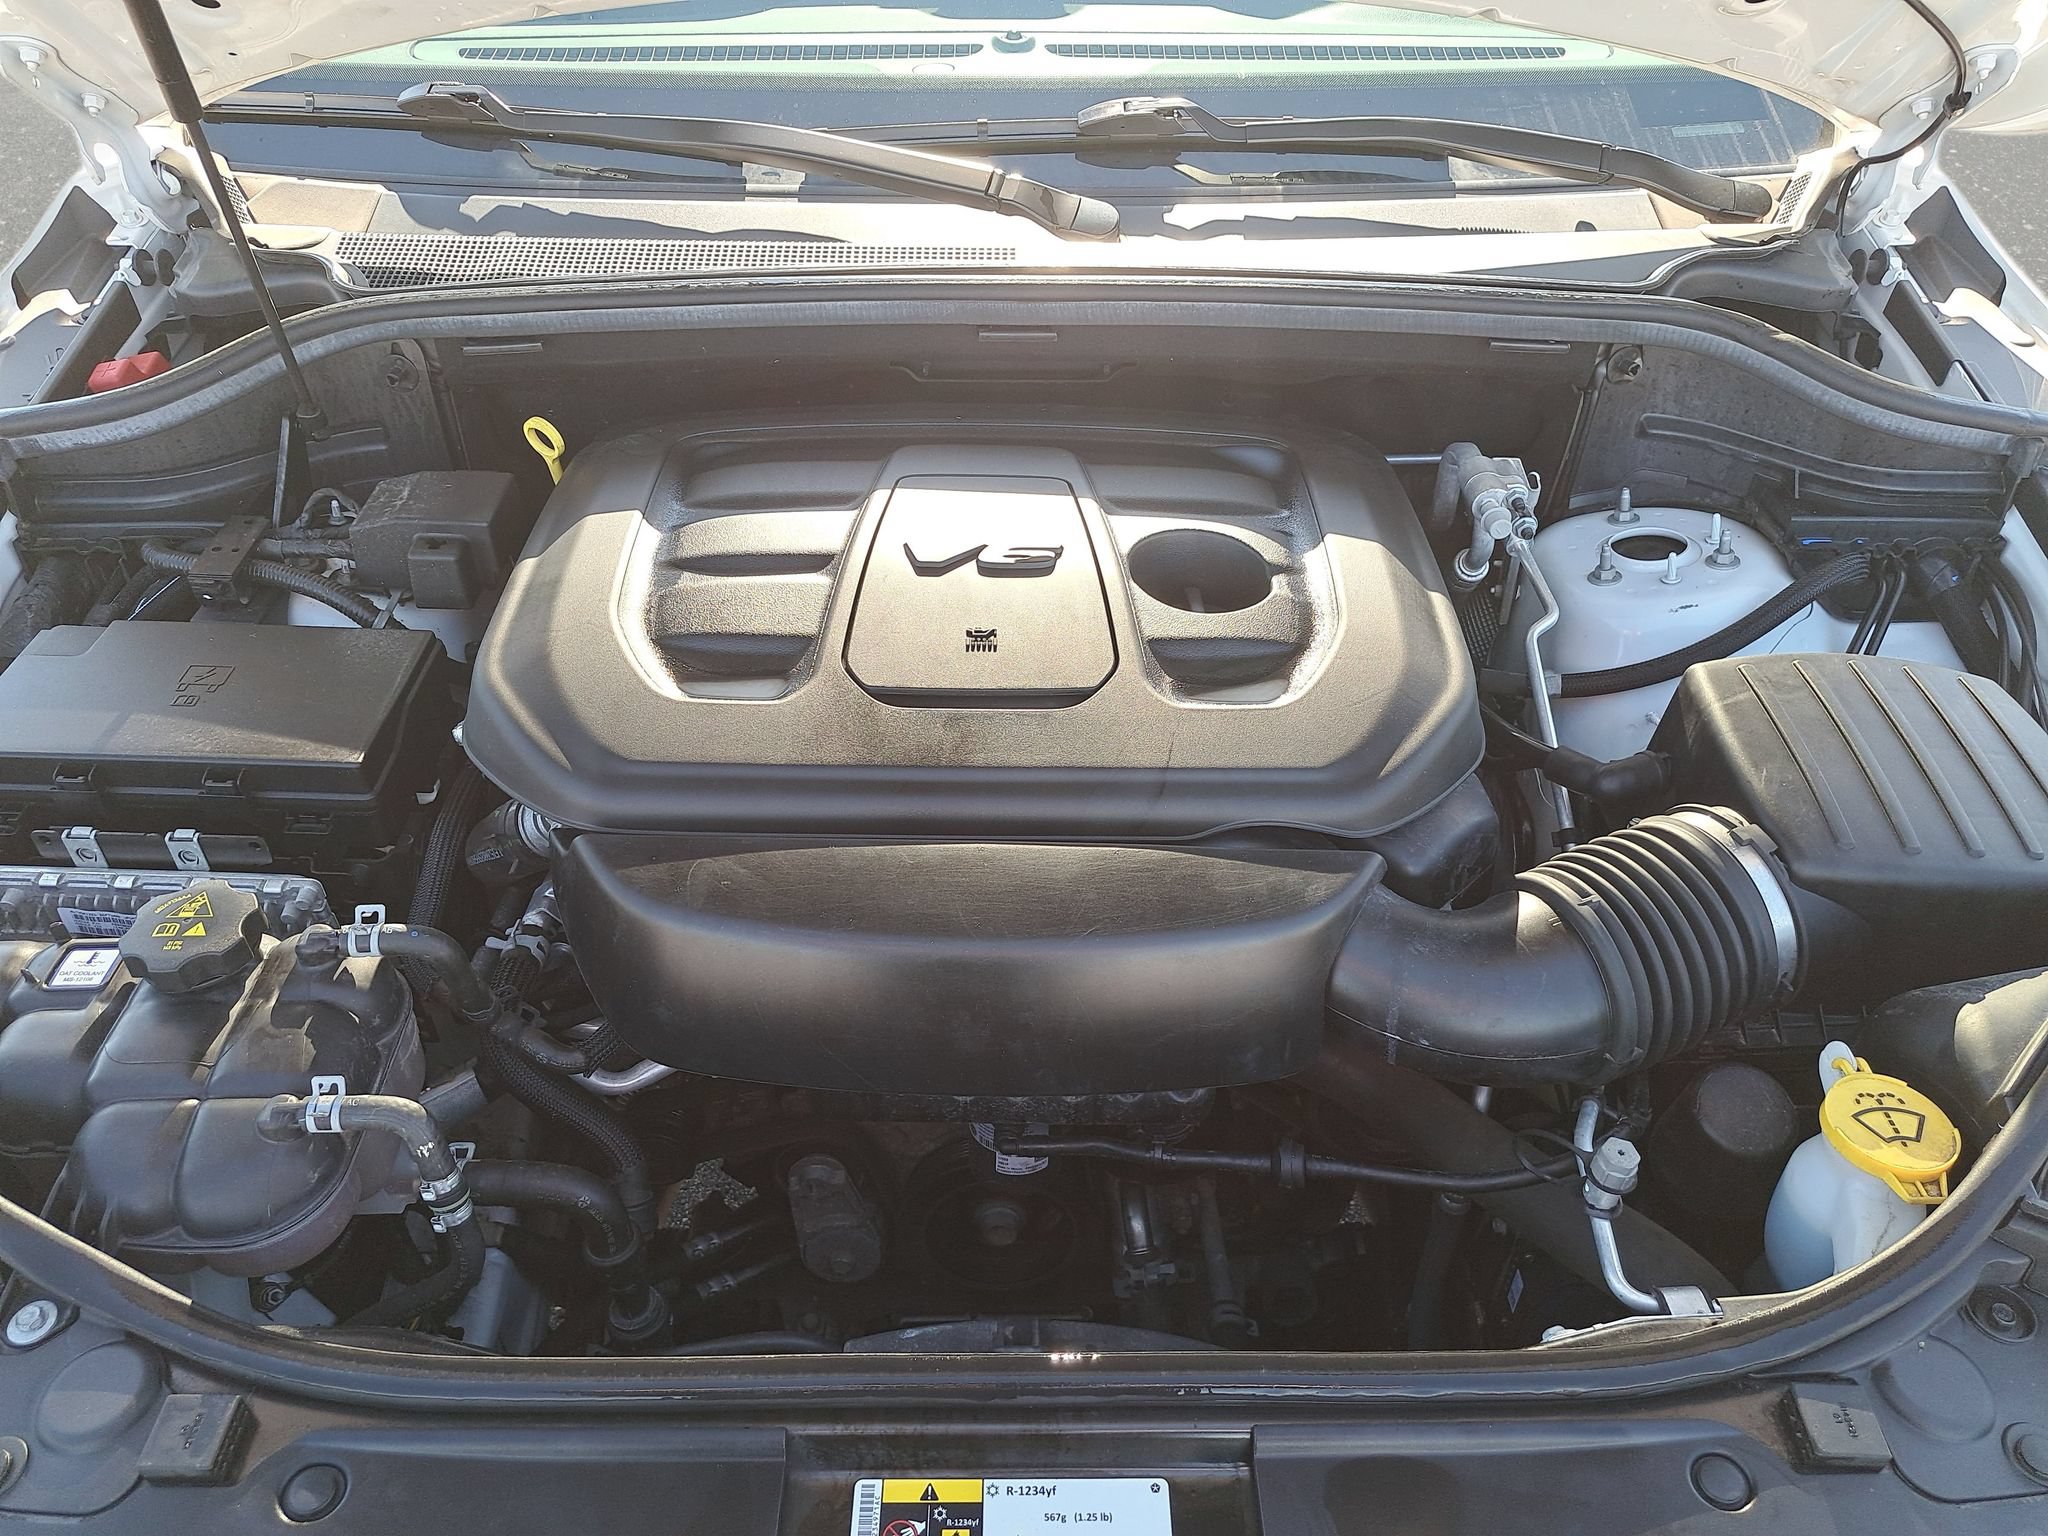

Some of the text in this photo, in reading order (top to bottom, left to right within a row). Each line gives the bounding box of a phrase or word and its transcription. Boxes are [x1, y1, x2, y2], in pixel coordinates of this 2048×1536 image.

[1006, 1485, 1057, 1498] R-1234yf
[946, 1518, 980, 1527] R-1234yf
[1044, 1512, 1113, 1523] 567g (1.25 lb)
